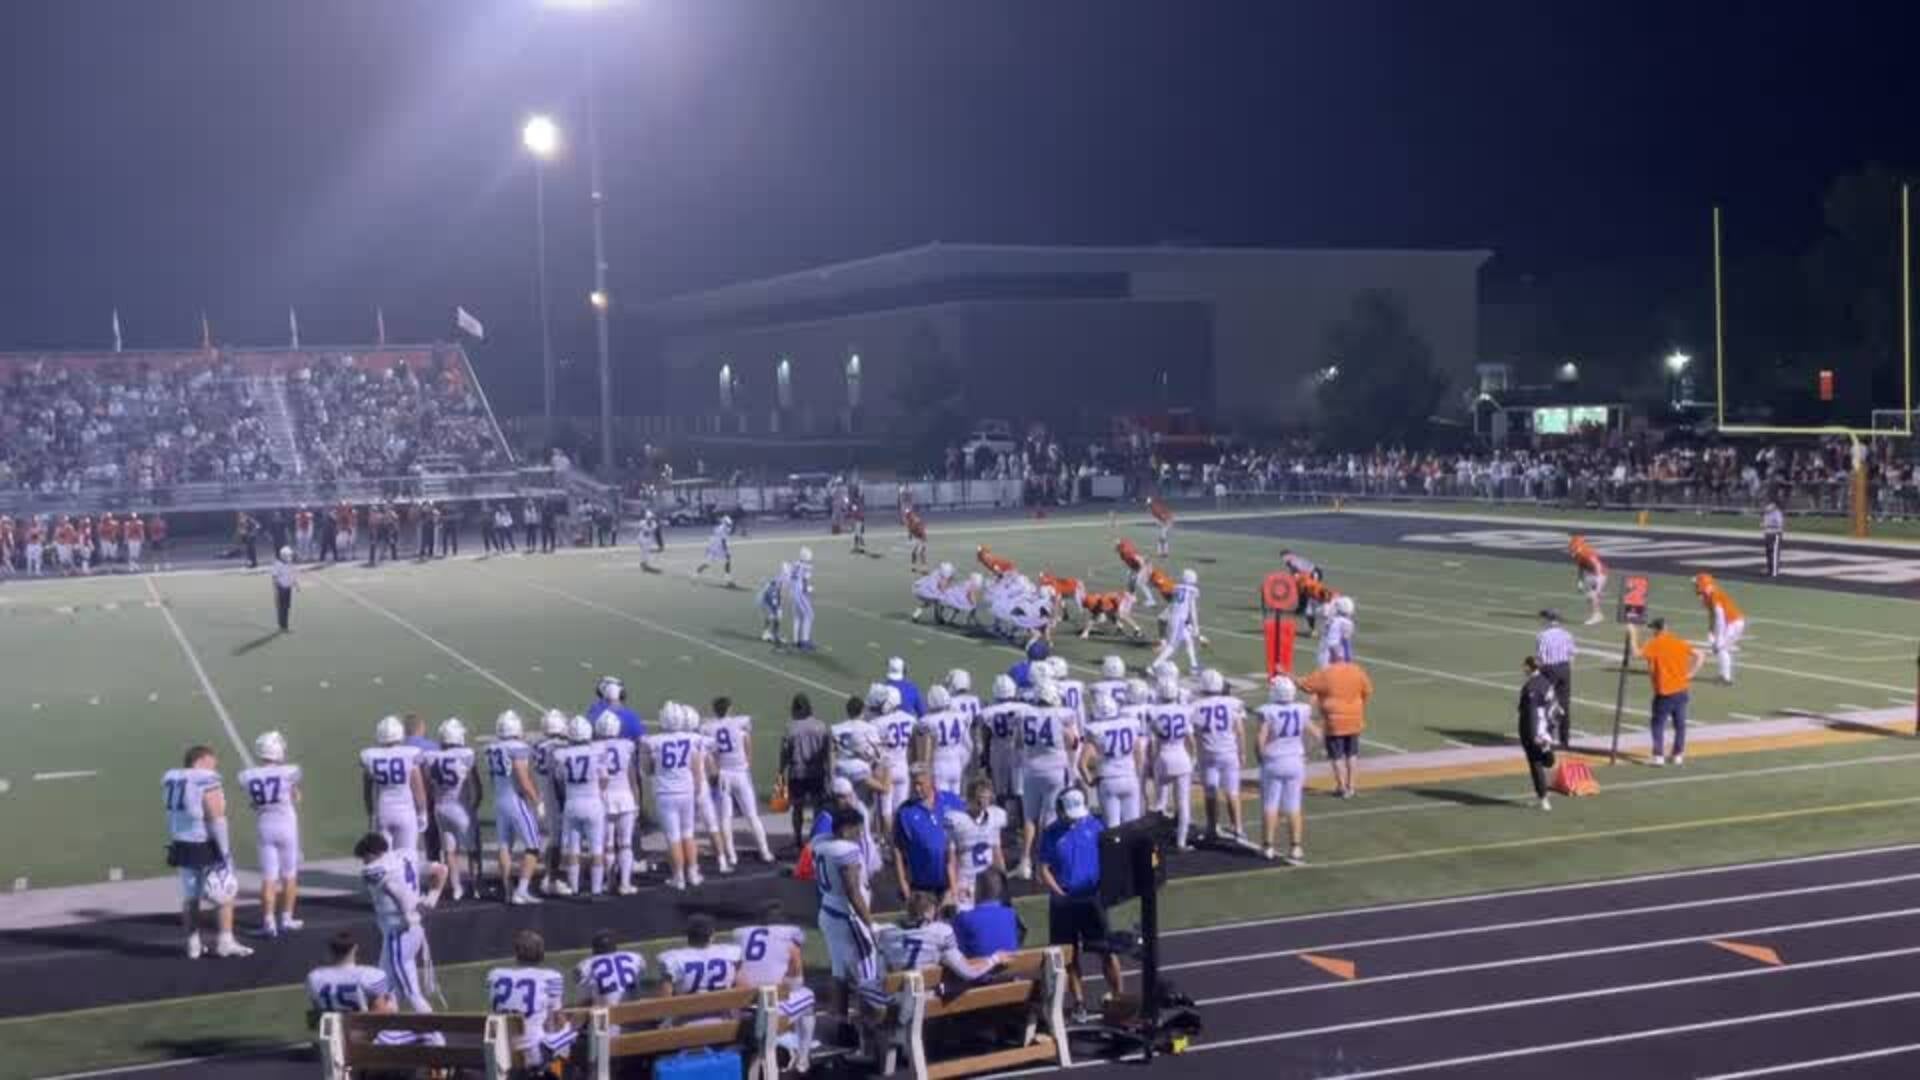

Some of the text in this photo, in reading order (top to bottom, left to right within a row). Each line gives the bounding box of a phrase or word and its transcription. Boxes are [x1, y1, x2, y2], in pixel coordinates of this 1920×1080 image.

[938, 717, 960, 746] 14
[1023, 716, 1054, 747] 54
[1158, 714, 1186, 740] 32
[1200, 704, 1228, 733] 79
[1279, 708, 1300, 737] 71
[716, 728, 733, 753] 9
[887, 721, 911, 748] 35
[1104, 728, 1132, 757] 70
[662, 739, 690, 769] 67
[373, 757, 406, 785] 58
[566, 755, 590, 783] 17
[248, 776, 280, 805] 87
[746, 928, 769, 961] 6
[903, 938, 922, 970] 7
[591, 955, 636, 994] 26
[685, 958, 727, 993] 72
[320, 983, 358, 1010] 15
[492, 977, 536, 1018] 23
